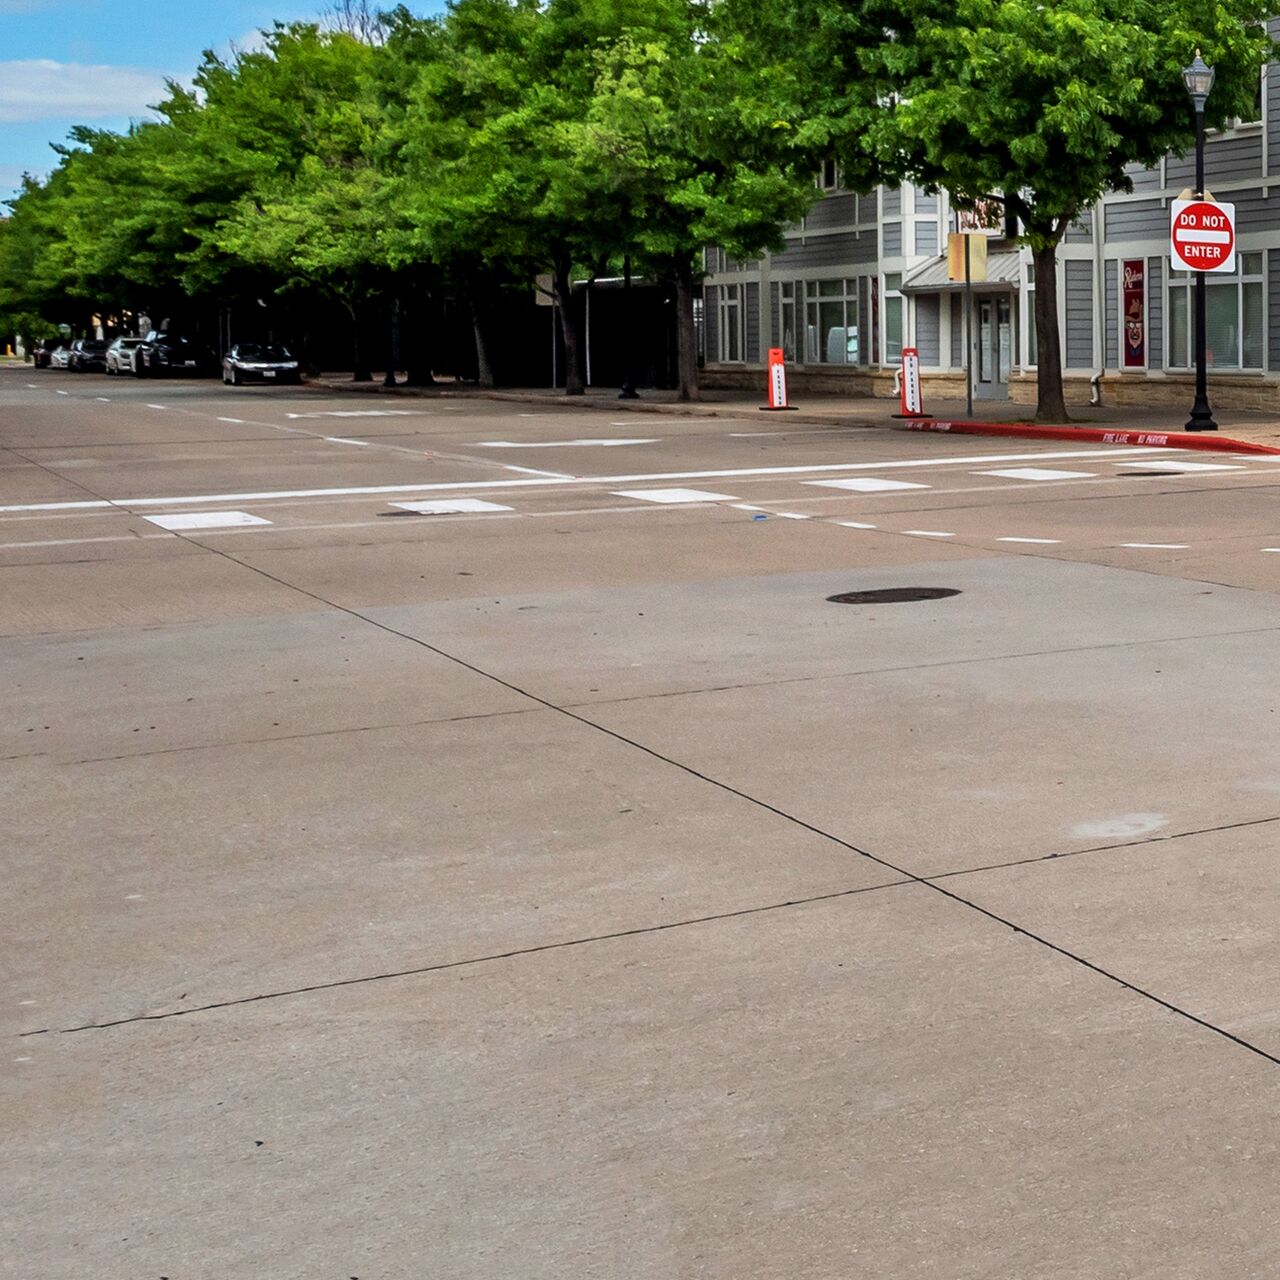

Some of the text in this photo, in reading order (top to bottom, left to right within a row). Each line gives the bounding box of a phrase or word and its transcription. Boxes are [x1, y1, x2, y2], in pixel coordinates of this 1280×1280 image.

[1181, 214, 1225, 227] DO NOT
[1184, 245, 1221, 258] ENTER
